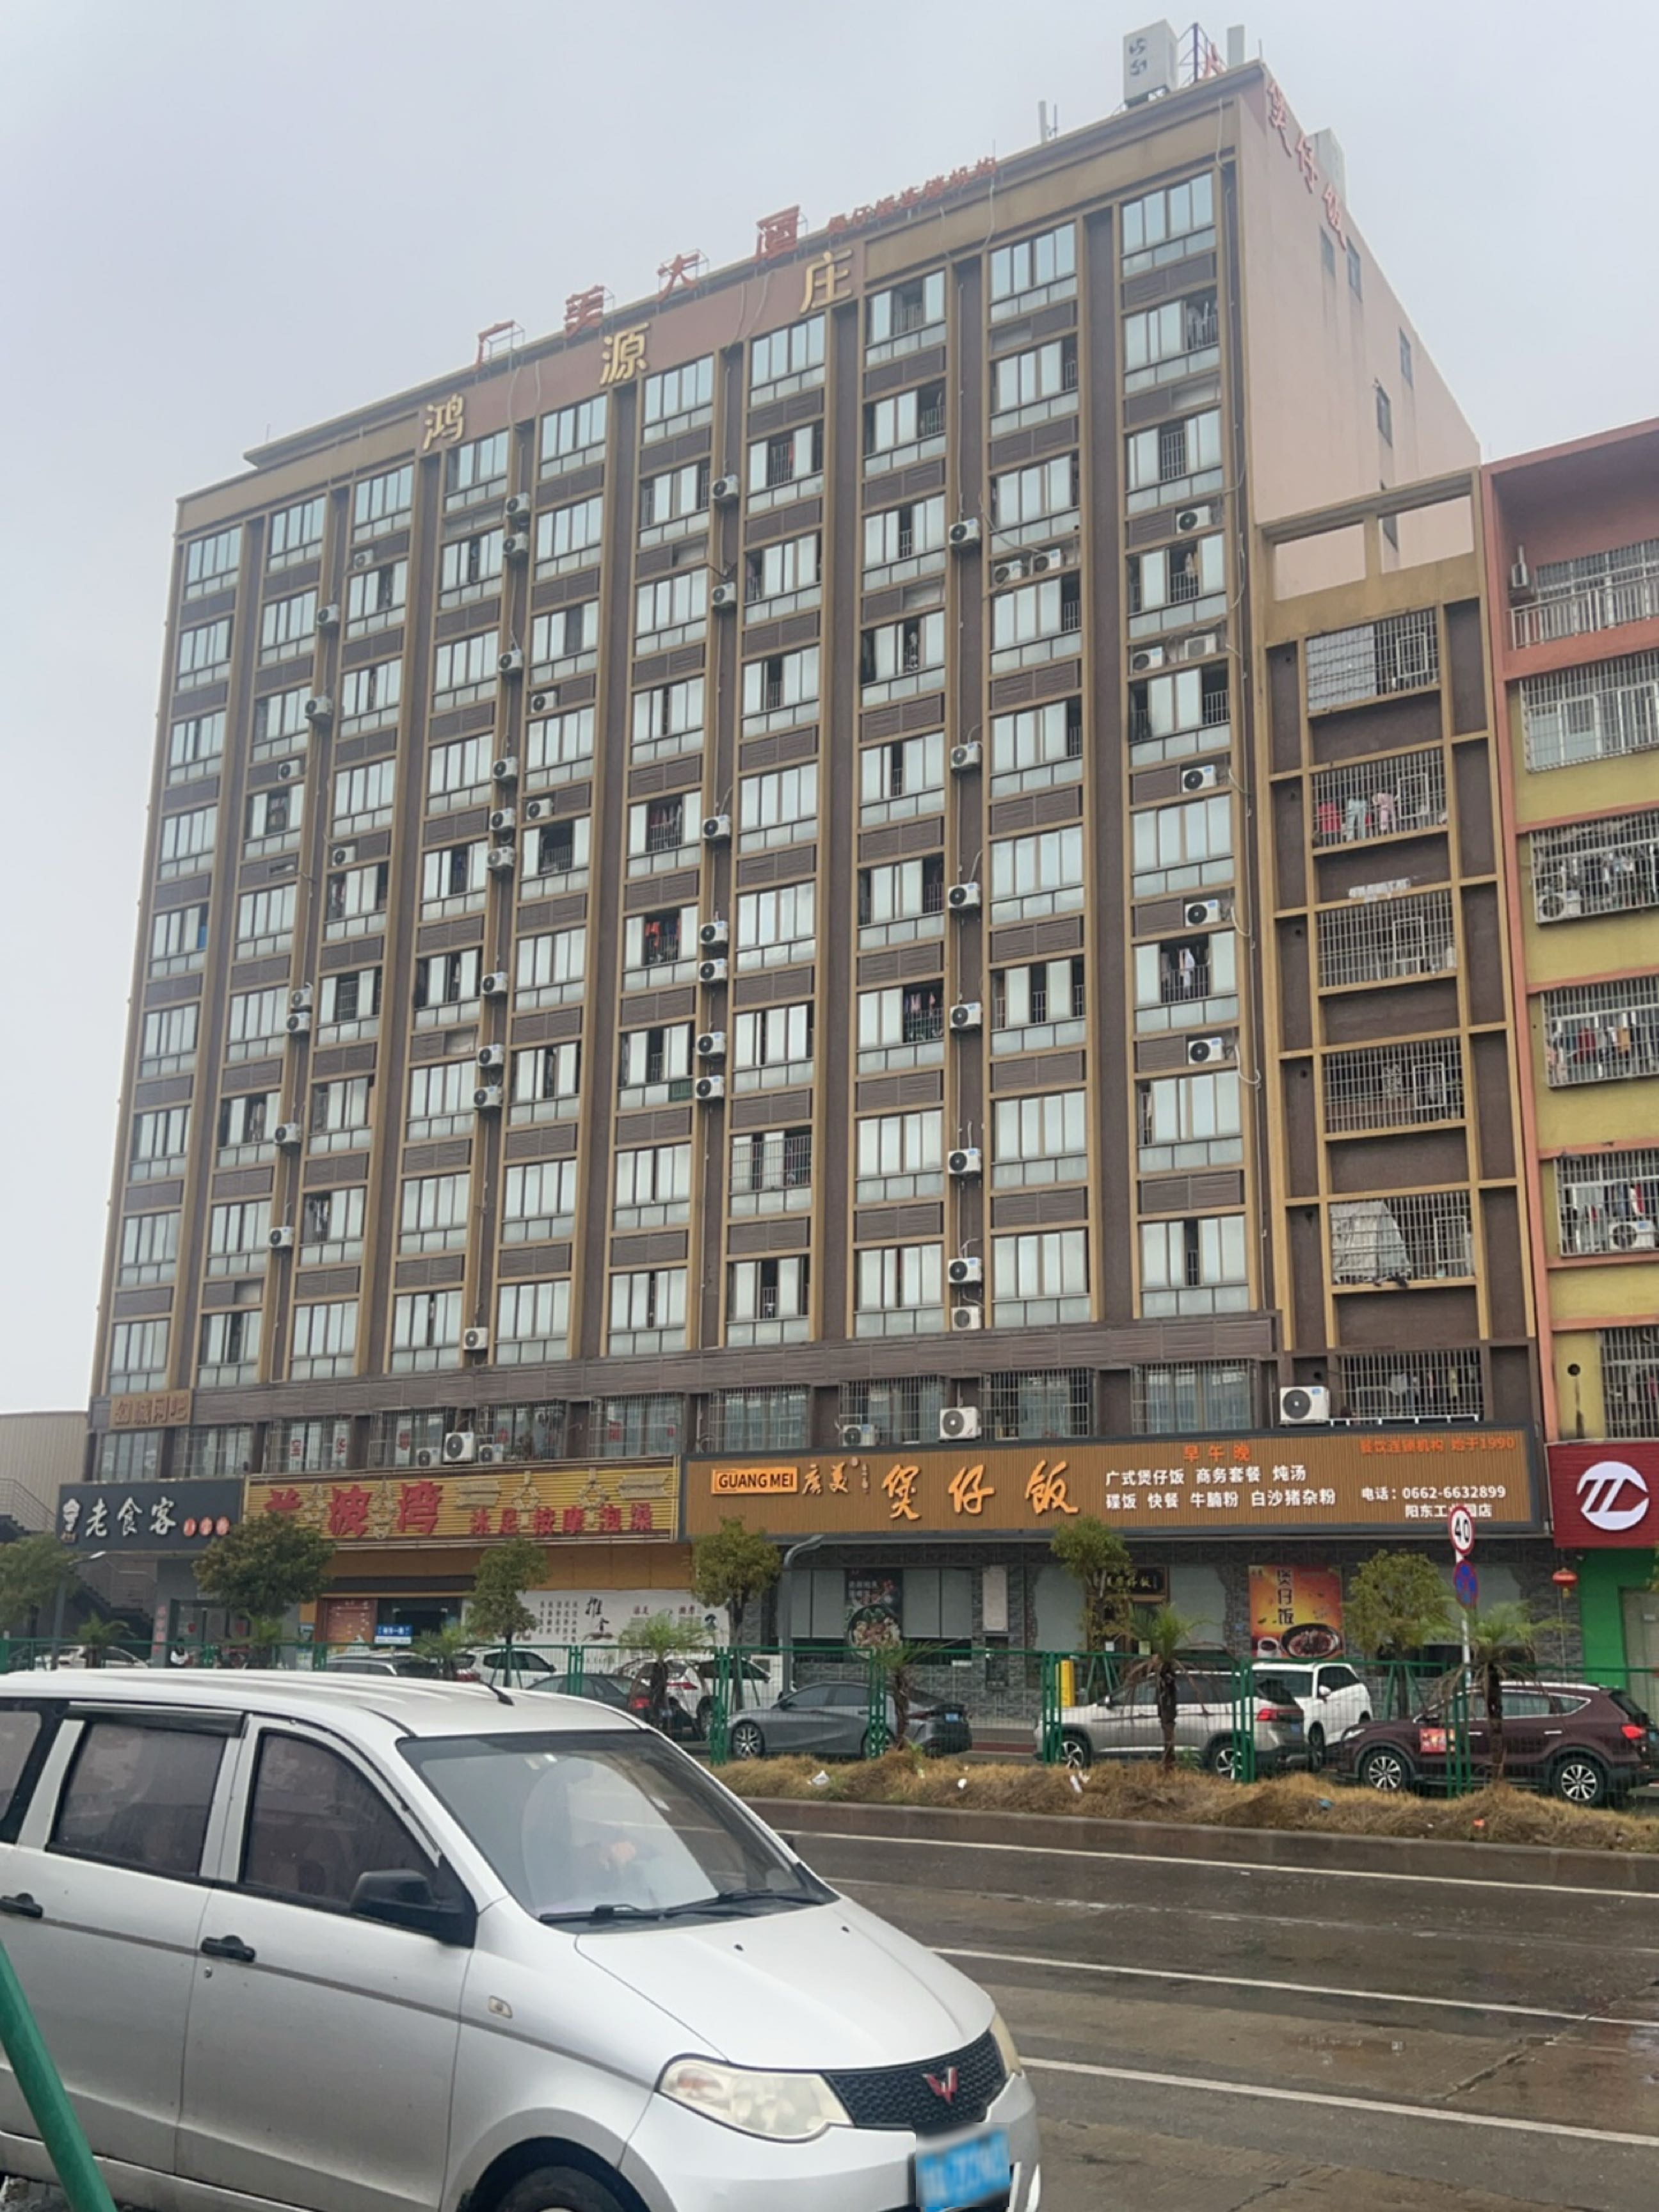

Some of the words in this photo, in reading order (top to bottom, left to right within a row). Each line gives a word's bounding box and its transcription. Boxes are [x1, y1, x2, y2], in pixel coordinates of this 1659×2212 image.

[423, 248, 853, 450] 鸿源庄
[718, 1473, 767, 1489] GUANG
[769, 1473, 794, 1488] MEI
[1106, 1469, 1184, 1487] 广式煲仔饭
[1196, 1466, 1261, 1484] 商务套餐
[1273, 1464, 1306, 1482] 炖汤
[1147, 1492, 1179, 1509] 快餐
[1190, 1491, 1239, 1509] 牛腩粉
[1251, 1488, 1336, 1507] 白沙猪杂粉
[86, 1496, 176, 1536] 老食客
[1405, 1503, 1492, 1518] 阳东工园店
[1454, 1516, 1470, 1543] 40
